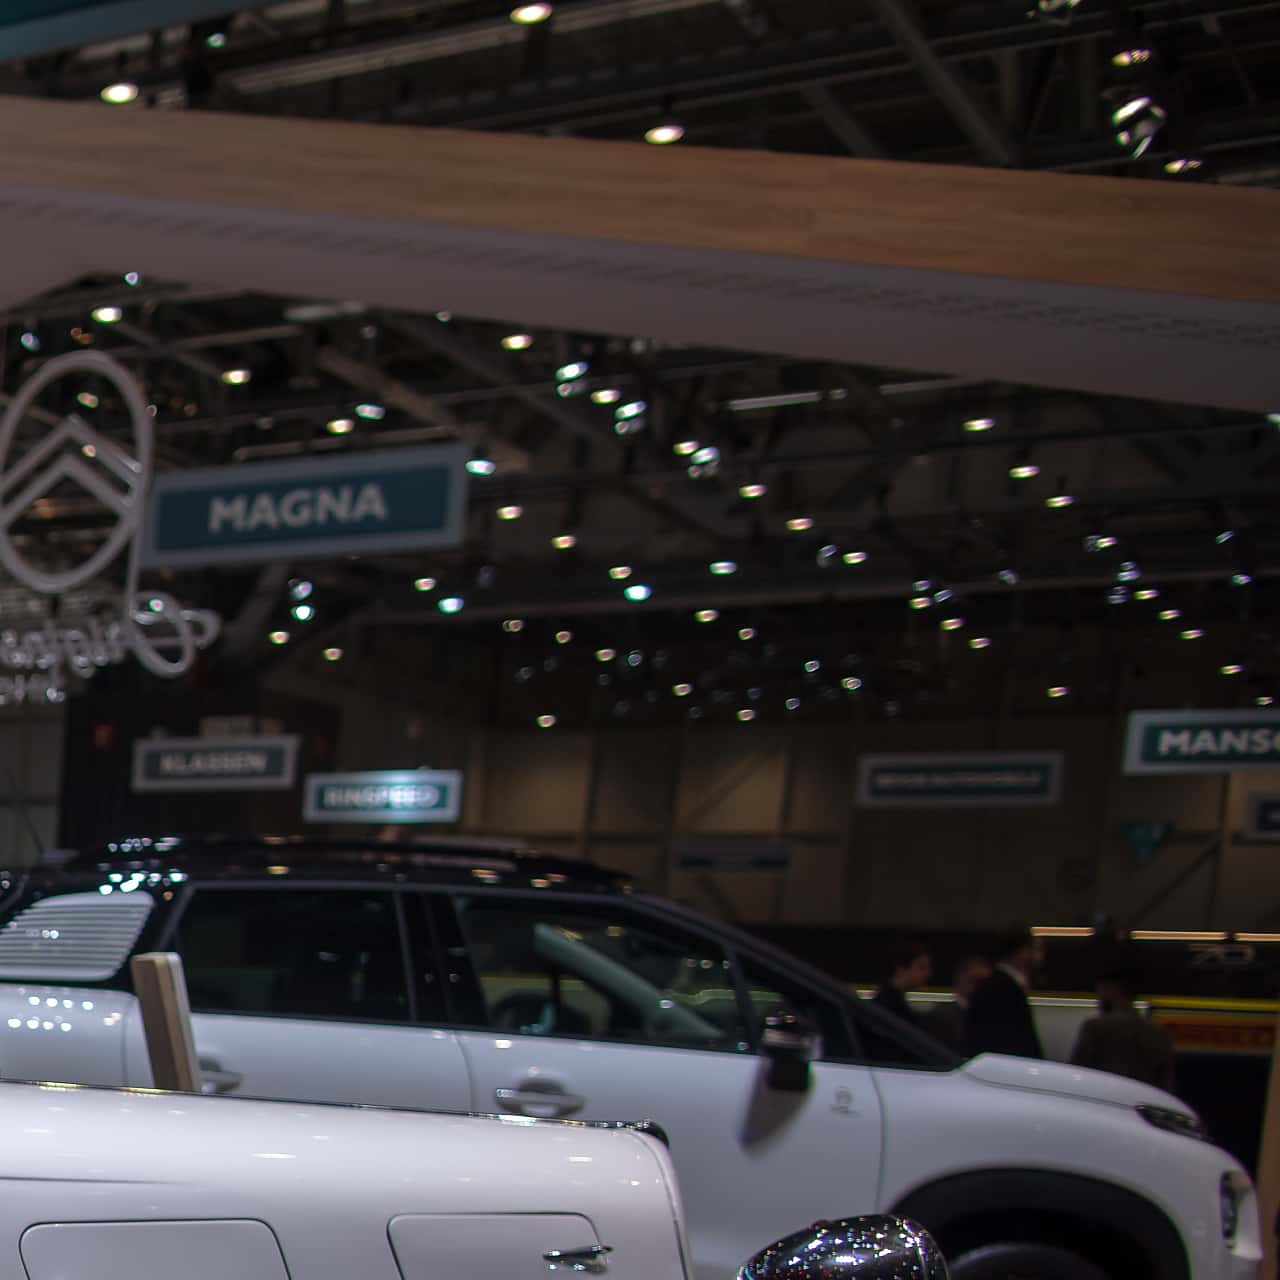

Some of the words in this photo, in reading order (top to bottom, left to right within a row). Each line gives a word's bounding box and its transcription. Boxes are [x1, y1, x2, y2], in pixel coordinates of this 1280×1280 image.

[207, 481, 389, 534] MAGNA
[160, 752, 267, 774] KLASSEN
[323, 785, 440, 808] RINSPEED
